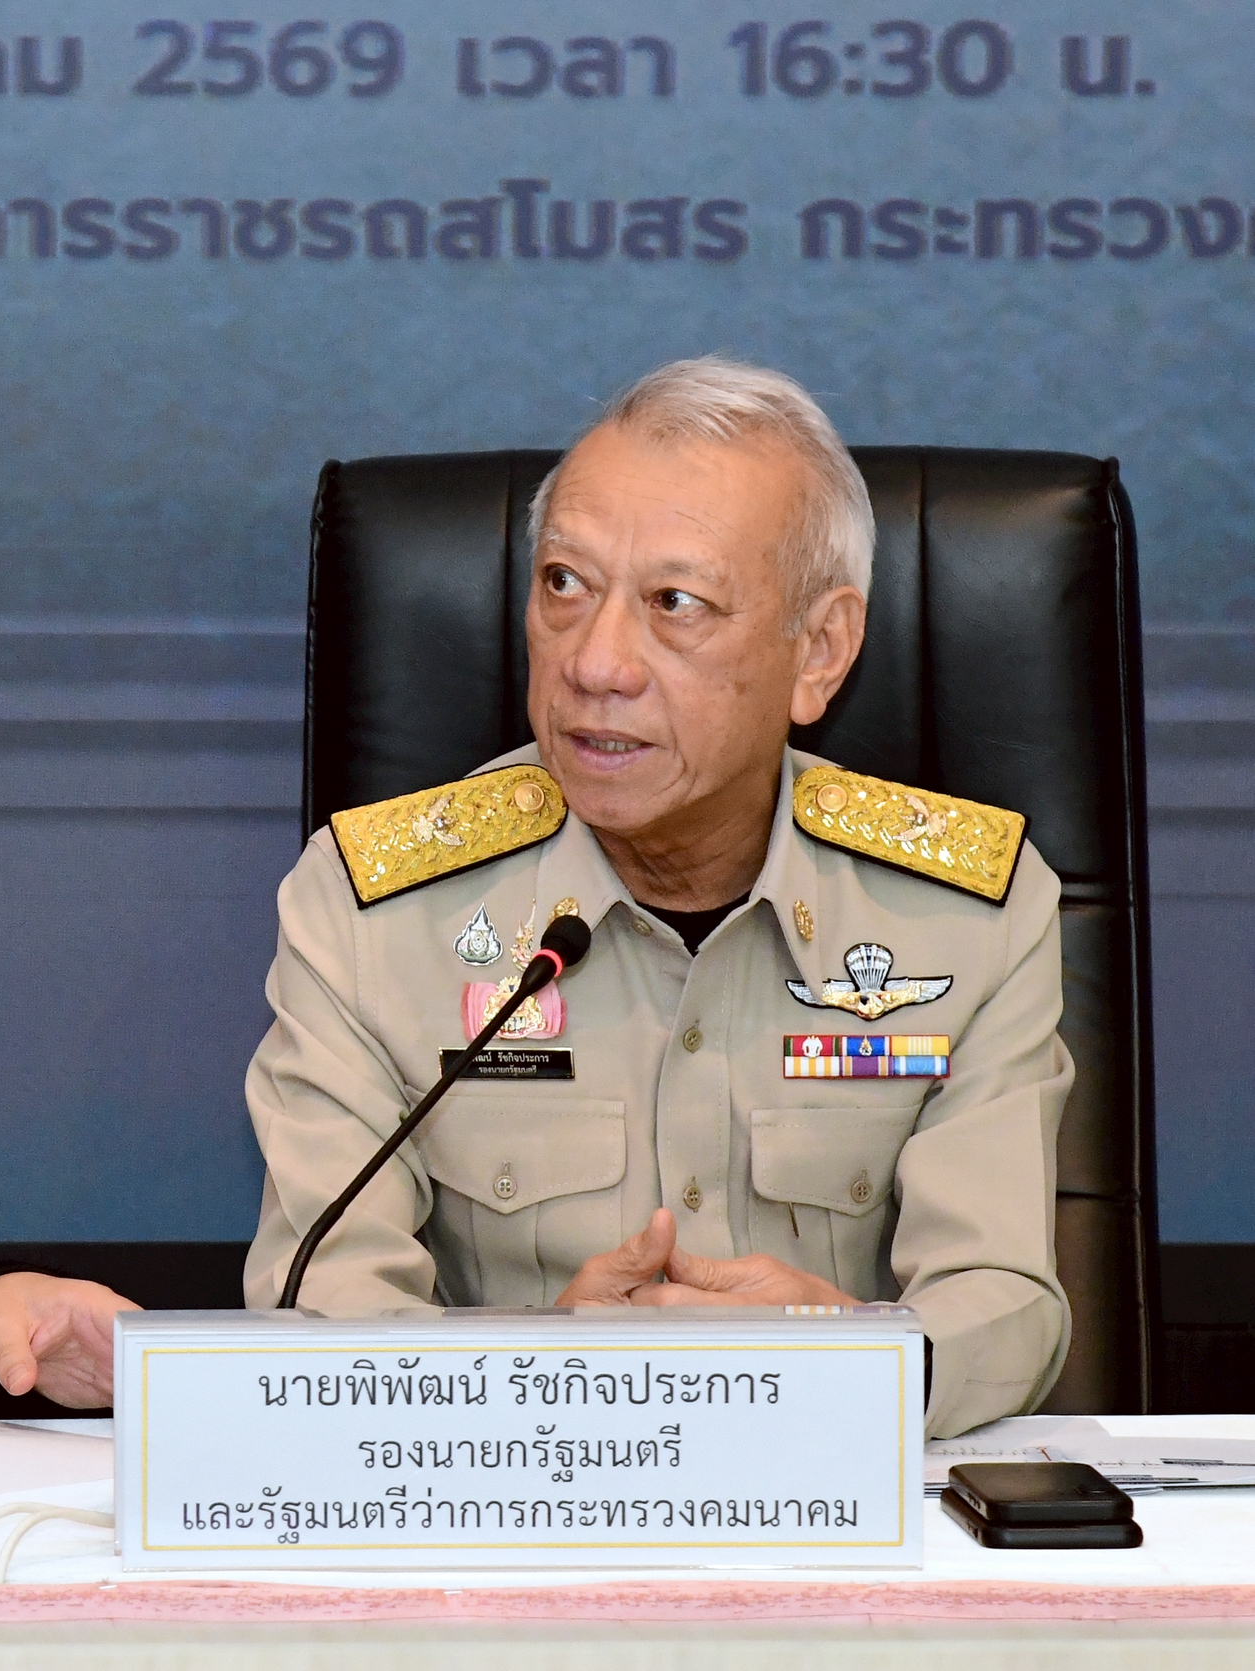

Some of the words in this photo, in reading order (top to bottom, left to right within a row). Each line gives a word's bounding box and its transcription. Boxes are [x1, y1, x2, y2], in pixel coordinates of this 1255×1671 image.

[132, 20, 403, 98] 2569
[456, 36, 676, 98] เวลา
[728, 20, 1014, 98] 16:30
[1062, 36, 1156, 97] น.
[800, 197, 1255, 261] กระทรวง
[258, 1355, 488, 1407] นายพิพัฒน์
[508, 1356, 781, 1406] รัชกิจประการ
[358, 1424, 682, 1483] รองนายกรัฐมนตรี
[183, 1485, 858, 1545] และรัฐมนตรีว่าการกระทรวงคมนาคม
